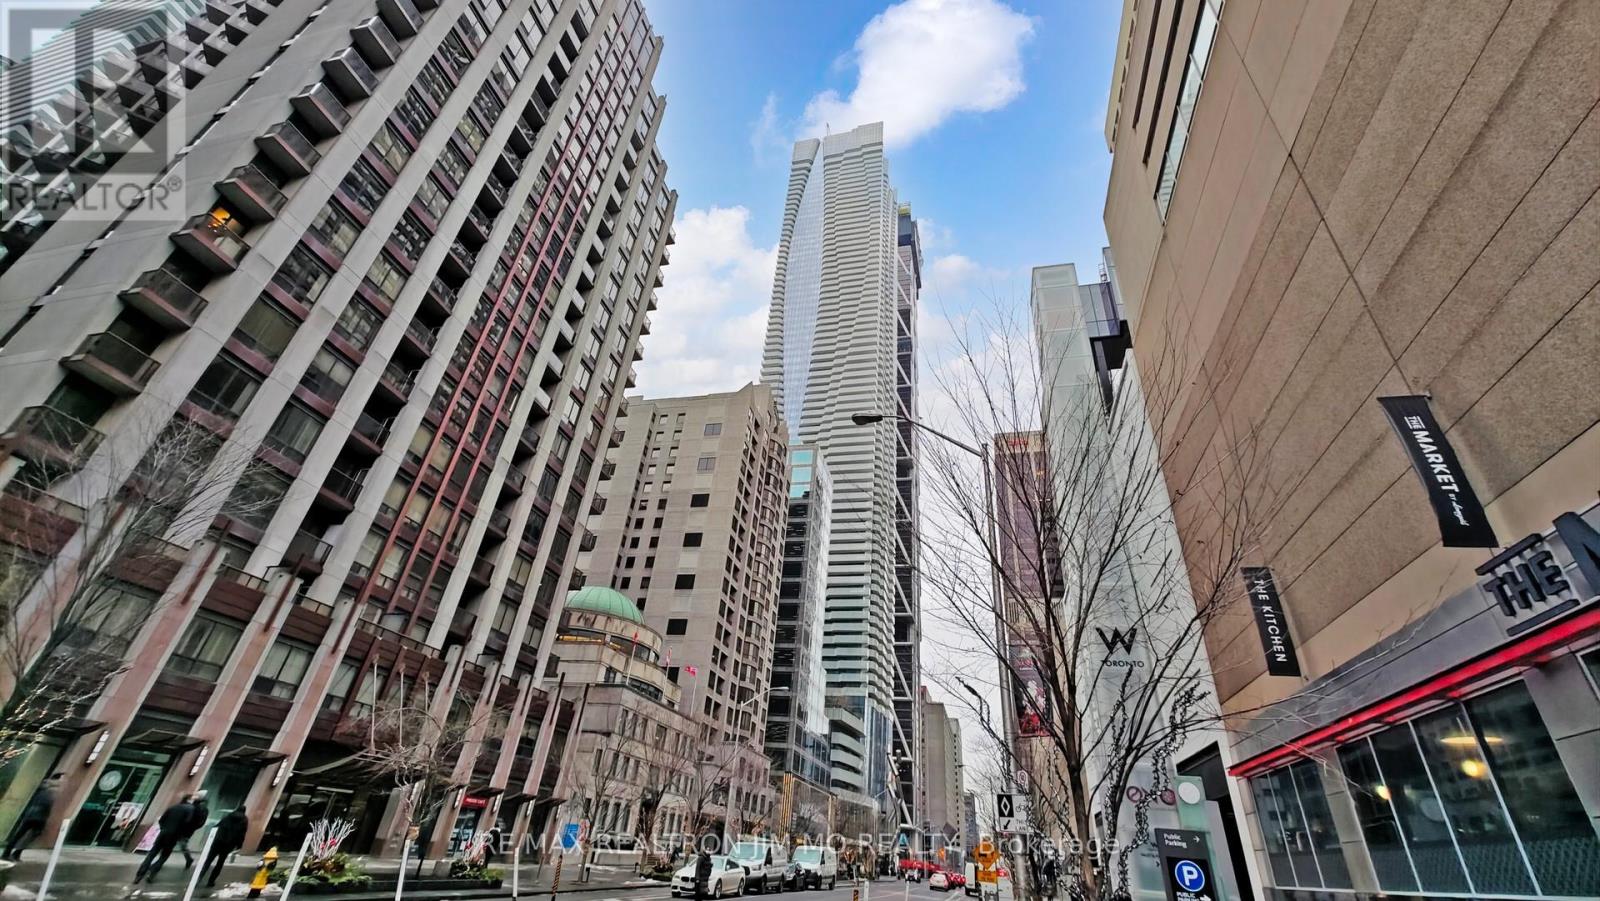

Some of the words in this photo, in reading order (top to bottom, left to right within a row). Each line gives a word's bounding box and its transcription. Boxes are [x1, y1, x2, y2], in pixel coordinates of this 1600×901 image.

[1406, 415, 1424, 429] THE
[1412, 430, 1460, 493] MARKET
[1482, 549, 1571, 617] THE
[1254, 579, 1270, 601] THE
[1262, 605, 1288, 662] KITCHEN
[1095, 626, 1138, 656] W
[1100, 659, 1145, 668] TORONTO
[1163, 833, 1181, 841] Public
[1165, 839, 1187, 848] Parking
[1181, 865, 1198, 886] P
